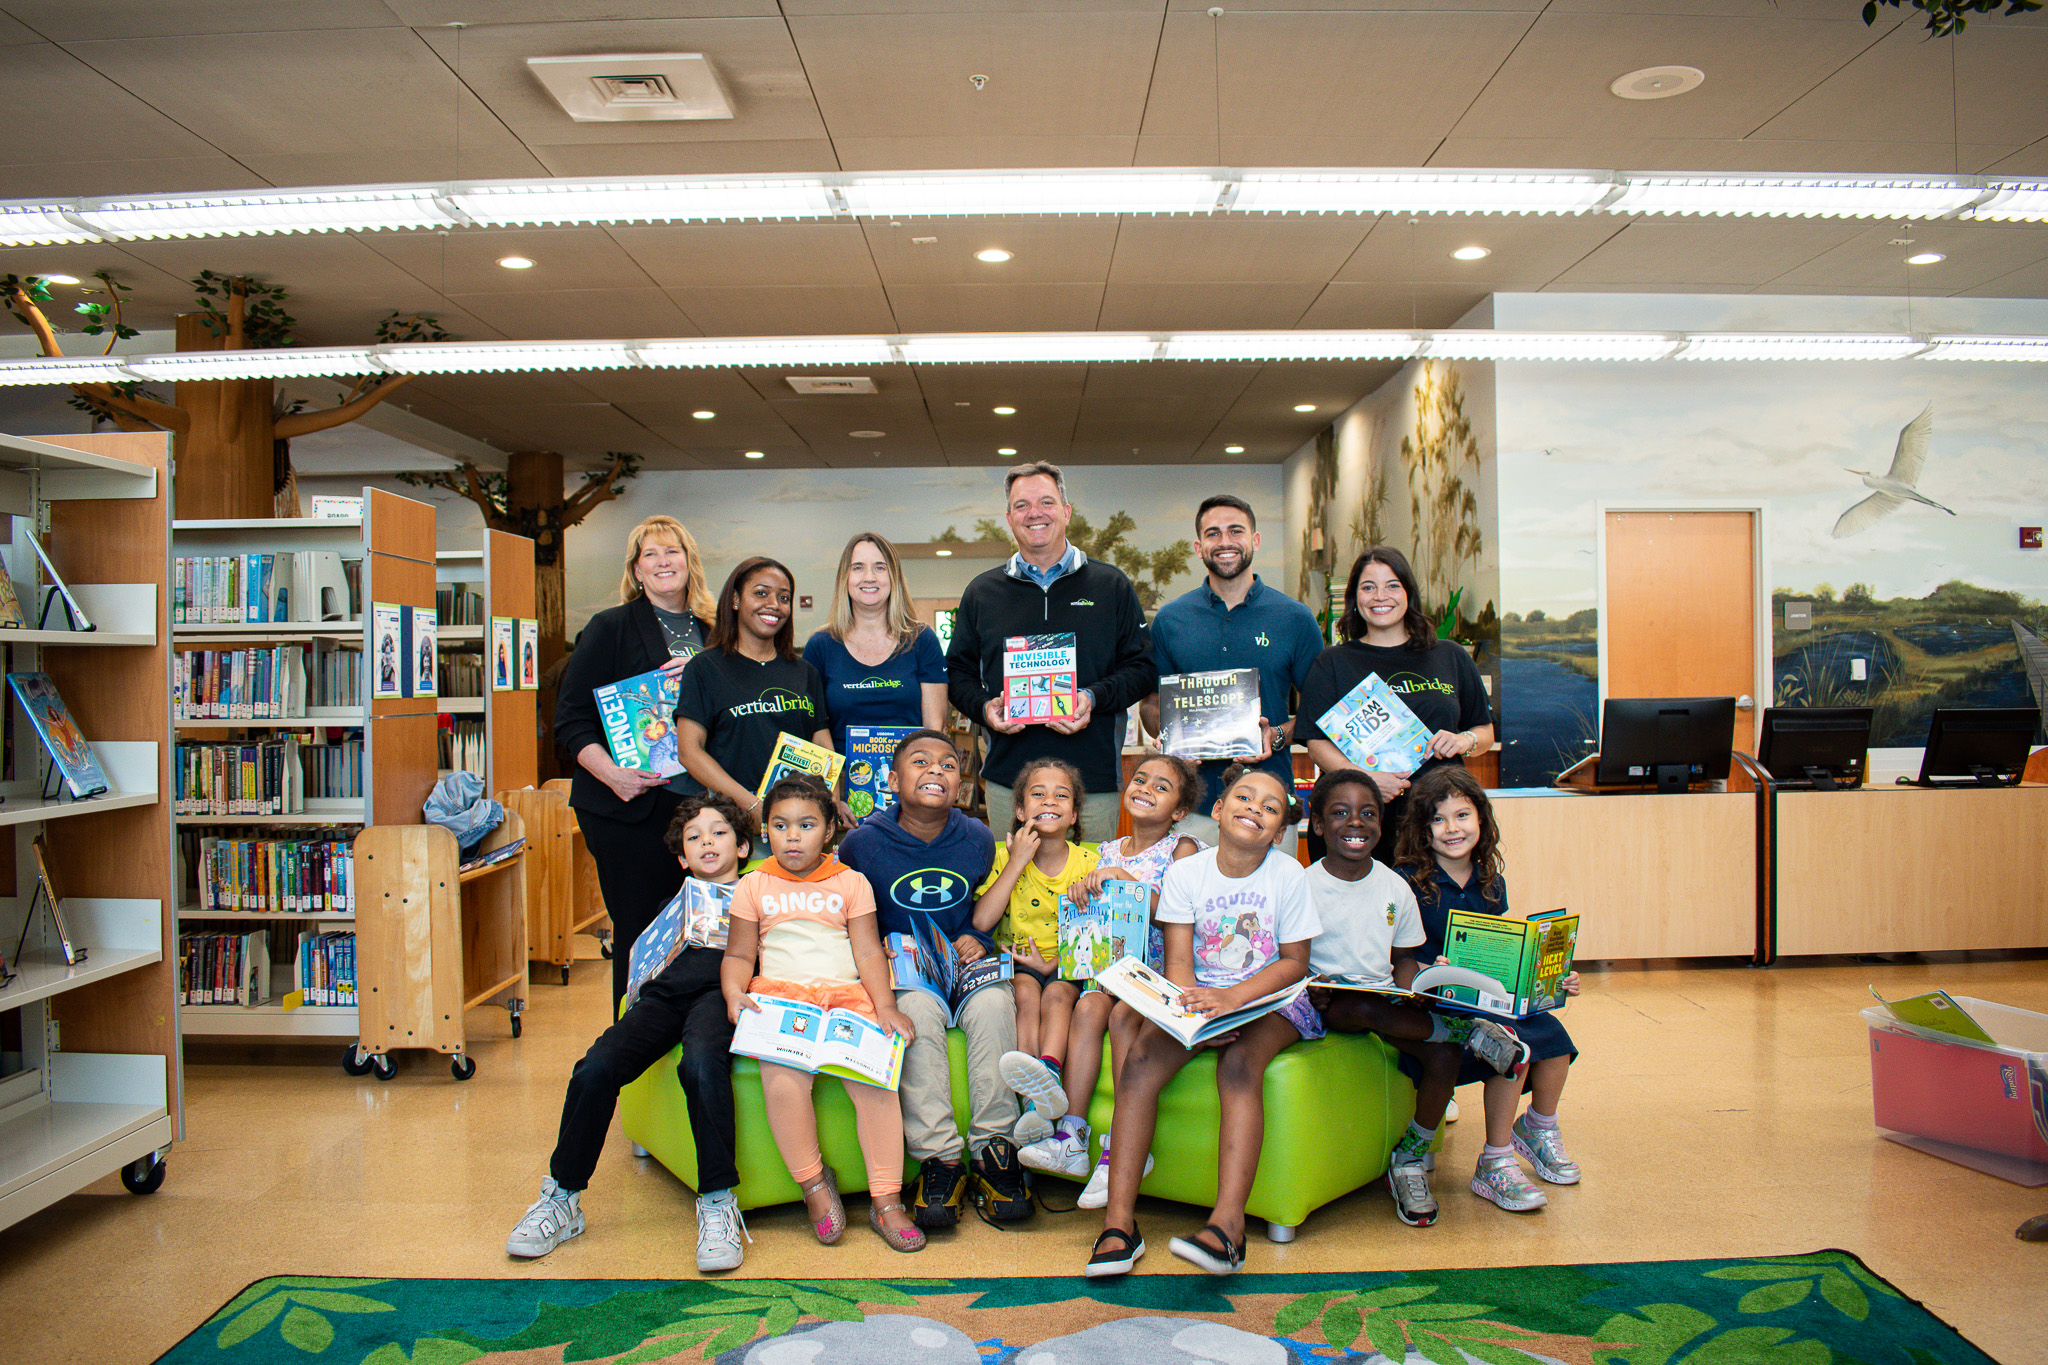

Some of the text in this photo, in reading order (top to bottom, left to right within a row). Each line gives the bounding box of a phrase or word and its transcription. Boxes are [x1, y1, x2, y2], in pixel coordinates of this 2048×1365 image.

[1009, 658, 1070, 669] TECHNOLOGY
[1013, 650, 1067, 661] INVISIBLE
[843, 679, 901, 689] verticalbridge
[1180, 674, 1237, 690] THROUGH
[1389, 678, 1455, 695] calbridge
[729, 695, 814, 718] verticalbridg
[1174, 692, 1245, 709] TELESCOPE
[1345, 700, 1380, 732] STEAM
[600, 692, 641, 769] CIENCE!
[1350, 707, 1390, 744] KIDS
[762, 892, 843, 915] BINGO
[1206, 892, 1266, 912] SQUISH
[1542, 952, 1564, 966] NEXT
[1540, 964, 1563, 978] LEVEL
[2004, 1066, 2018, 1099] Reading
